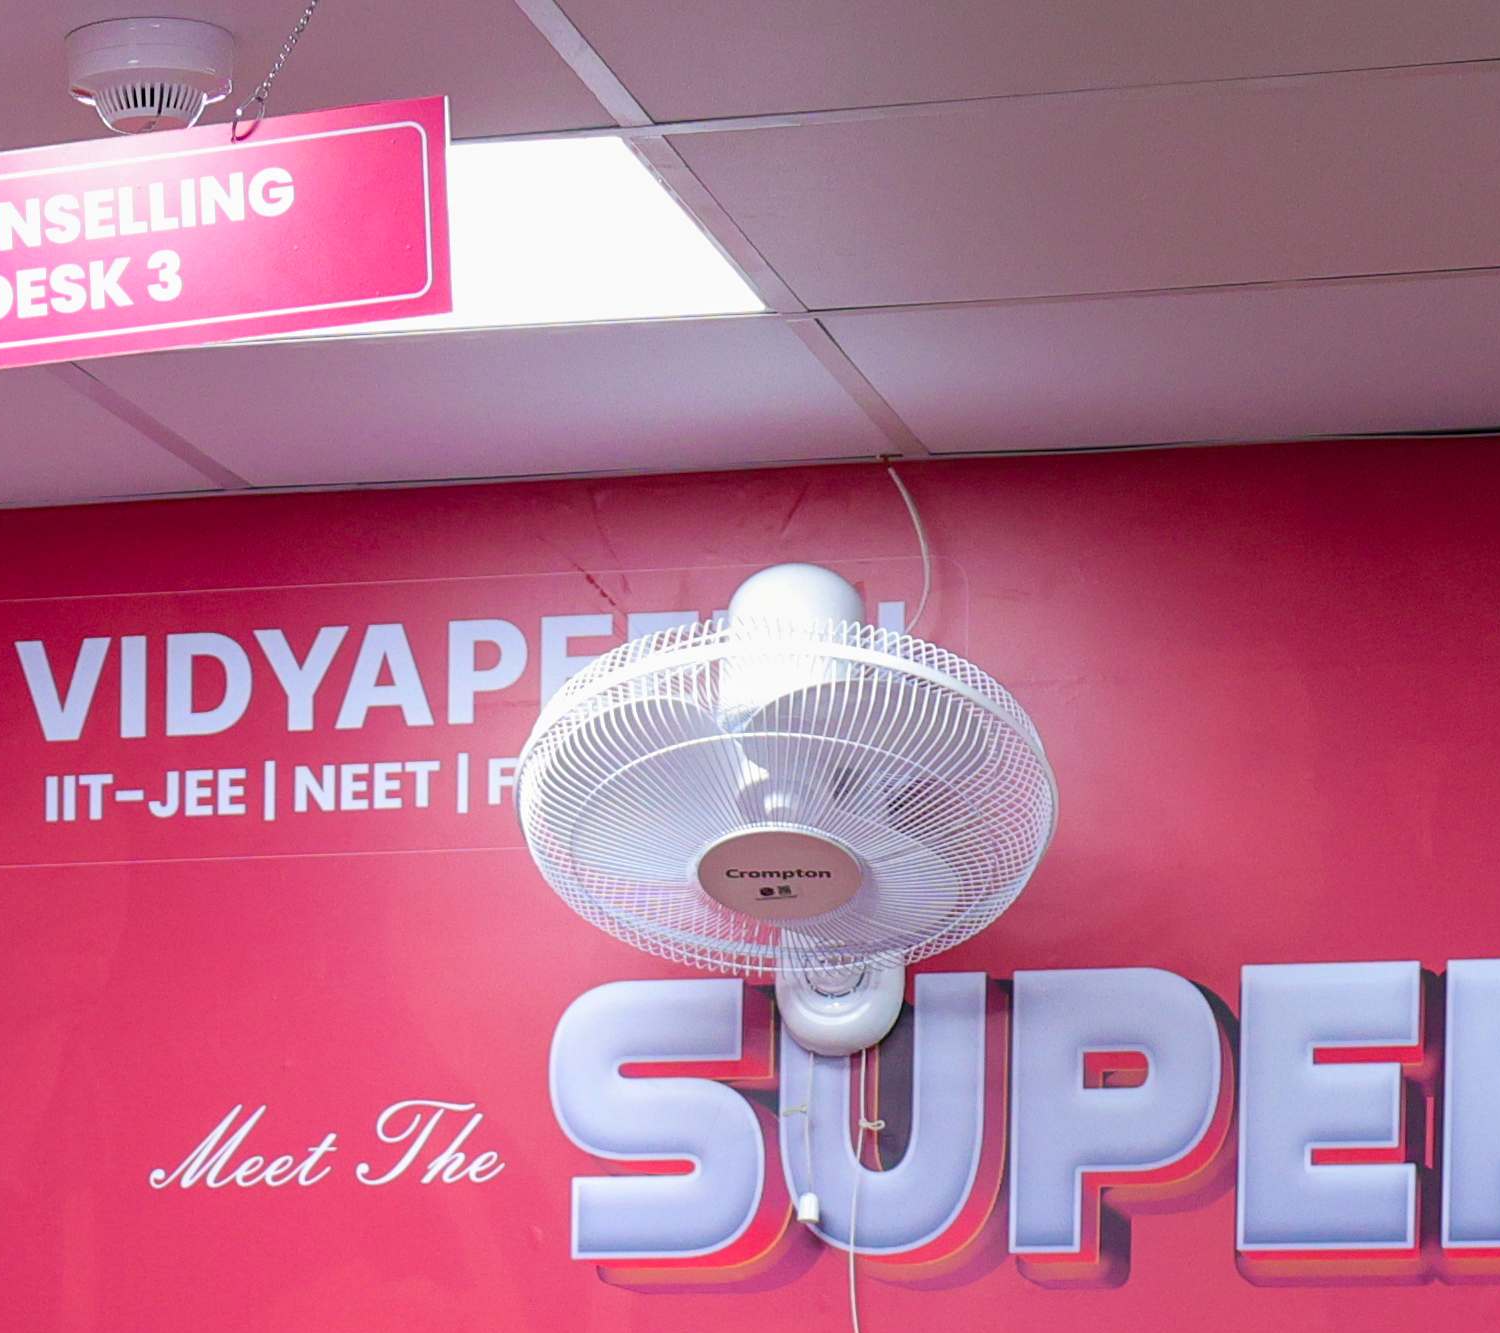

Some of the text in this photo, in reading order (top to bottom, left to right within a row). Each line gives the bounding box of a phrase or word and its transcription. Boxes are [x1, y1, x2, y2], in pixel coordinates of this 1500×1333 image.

[147, 250, 183, 303] 3
[16, 600, 906, 743] VIDYAPE
[44, 765, 247, 824] IIT-JEE
[293, 761, 433, 814] NEET
[725, 868, 832, 880] Crompton
[148, 1103, 332, 1192] Meet
[356, 1099, 507, 1188] The
